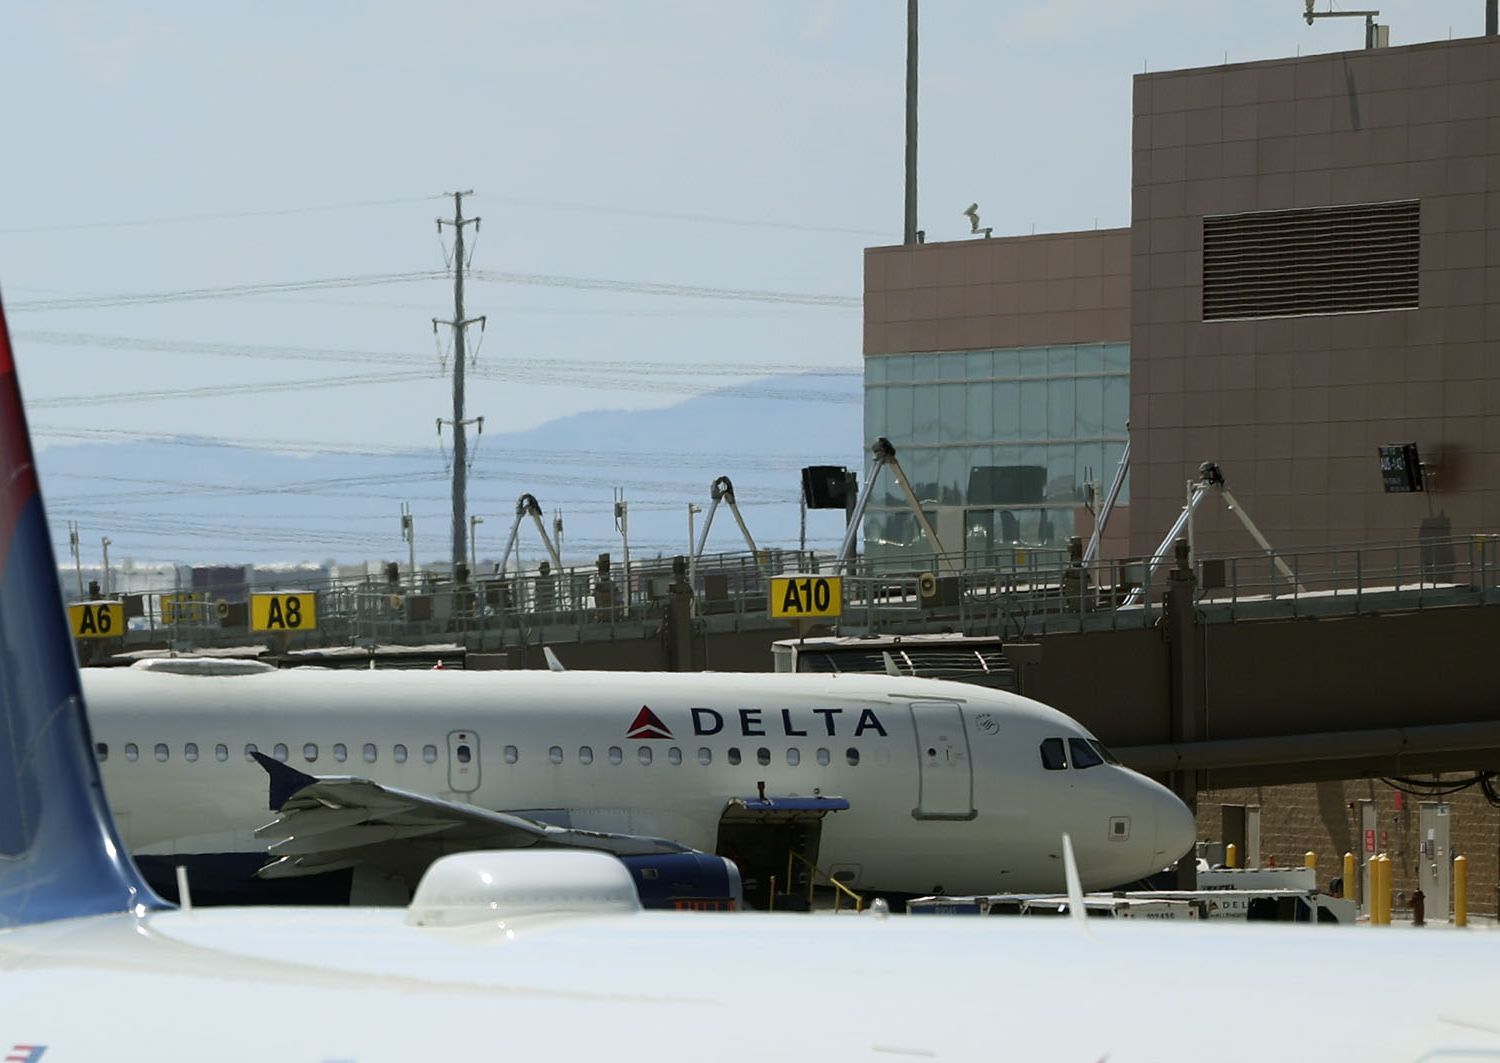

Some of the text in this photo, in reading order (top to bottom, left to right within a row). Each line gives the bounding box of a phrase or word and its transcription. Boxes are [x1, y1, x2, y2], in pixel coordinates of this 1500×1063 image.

[782, 578, 831, 613] A10
[79, 603, 112, 634] A6
[266, 596, 303, 629] A8
[690, 707, 888, 737] DELTA
[1222, 901, 1247, 909] DEL
